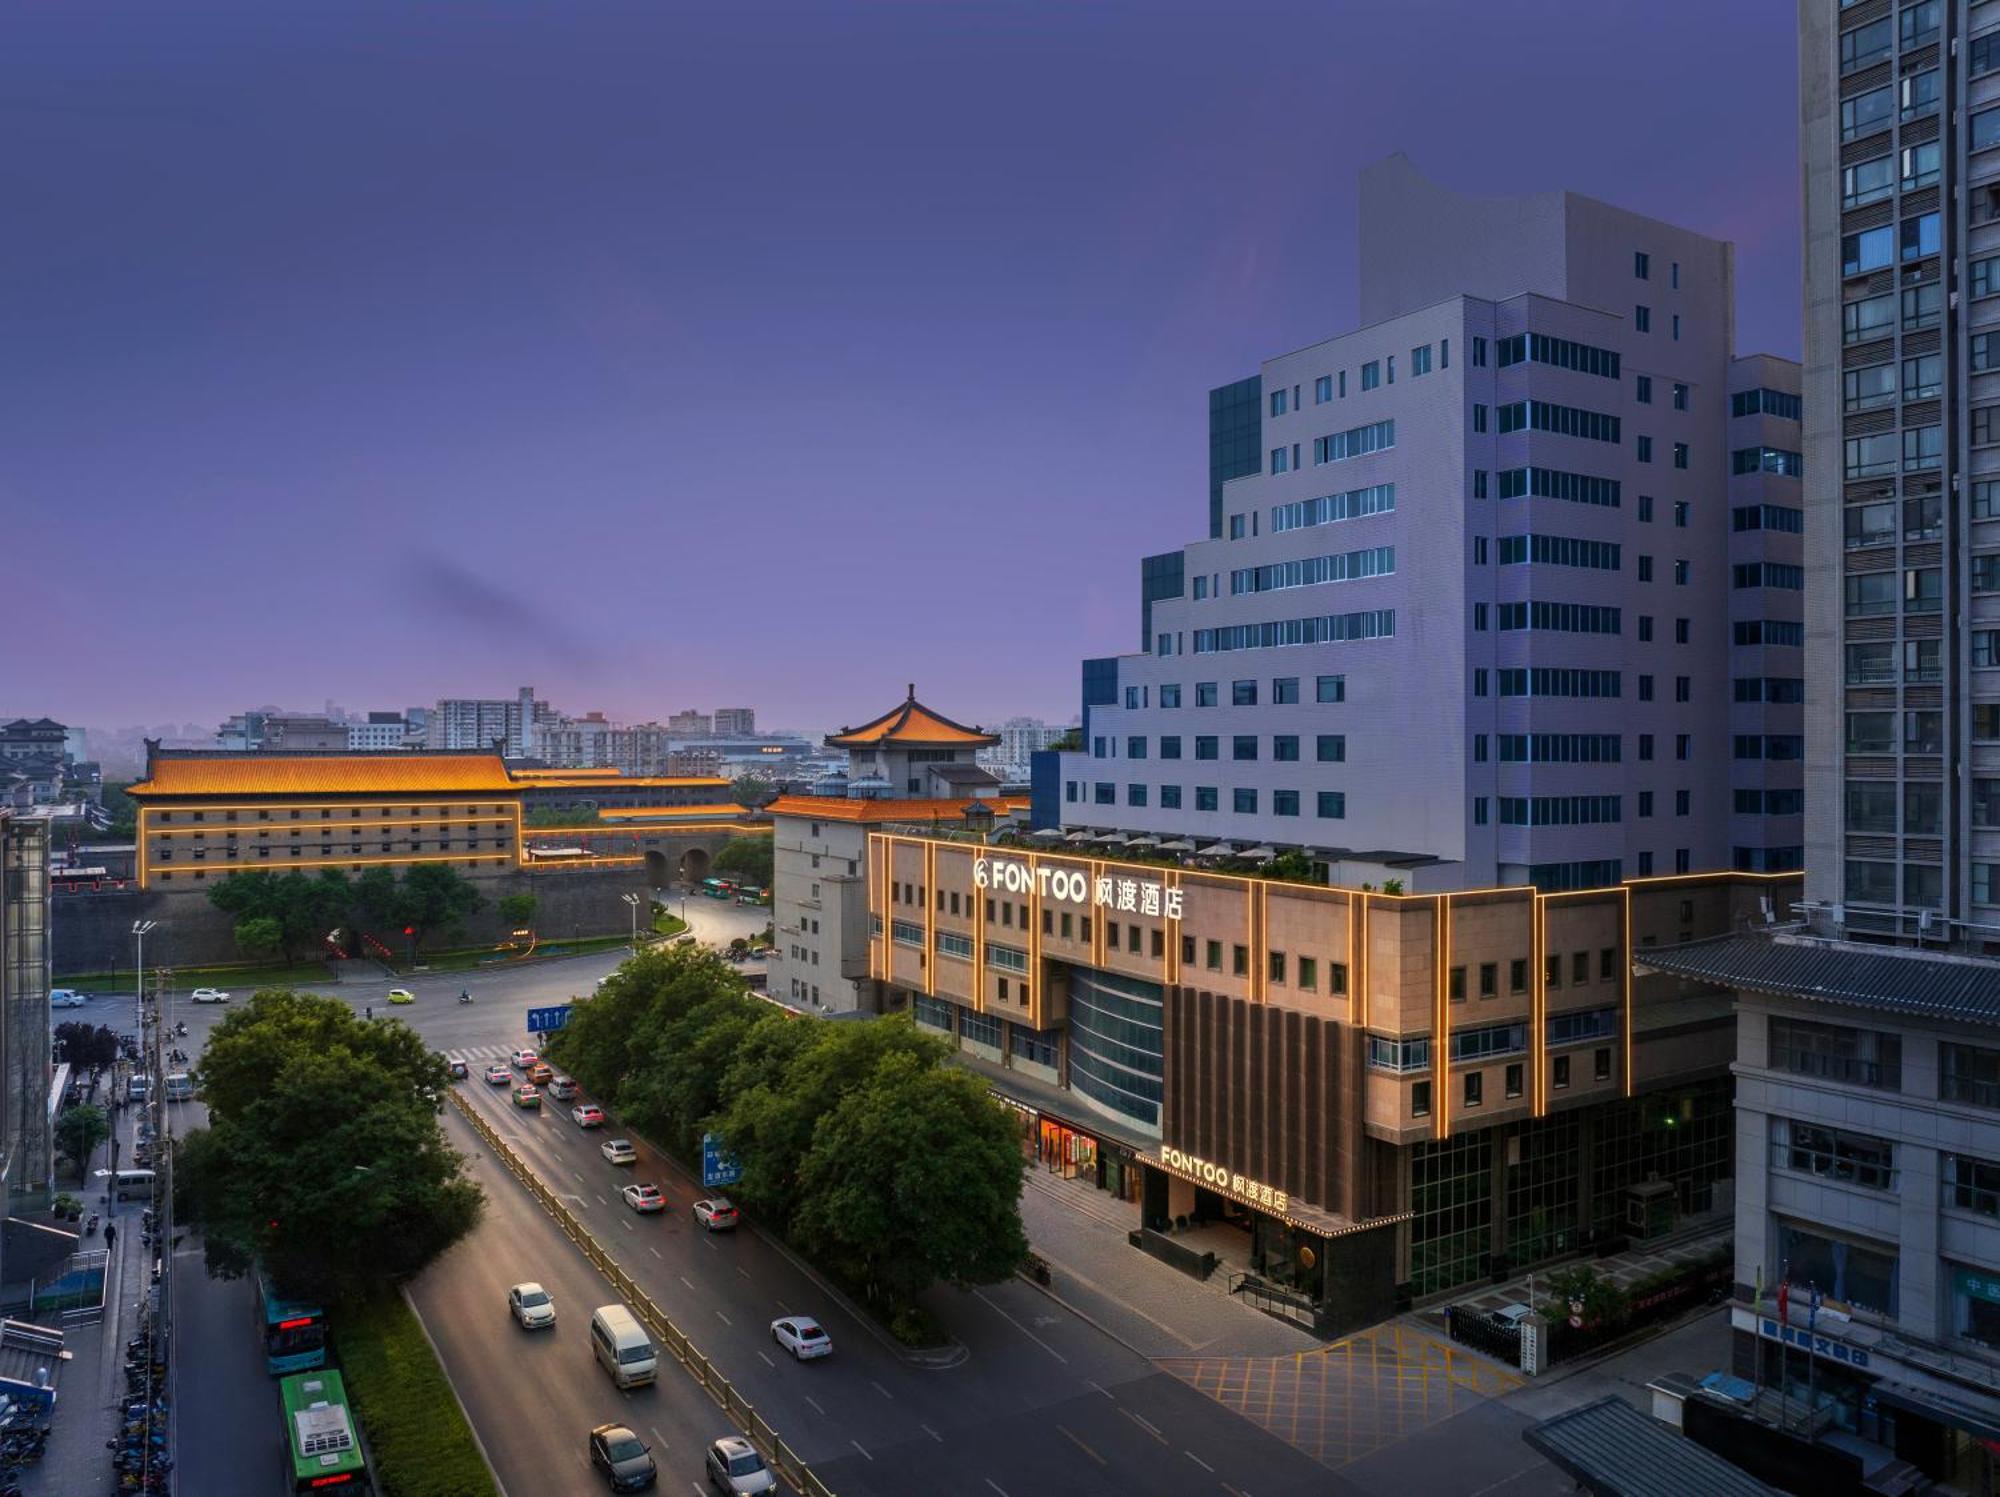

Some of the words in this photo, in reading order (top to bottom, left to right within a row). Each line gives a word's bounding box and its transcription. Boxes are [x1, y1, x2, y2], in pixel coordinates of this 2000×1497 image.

[993, 861, 1086, 903] FONTOO
[1094, 875, 1183, 920] 枫渡酒店
[1161, 1145, 1228, 1187] FONTOO
